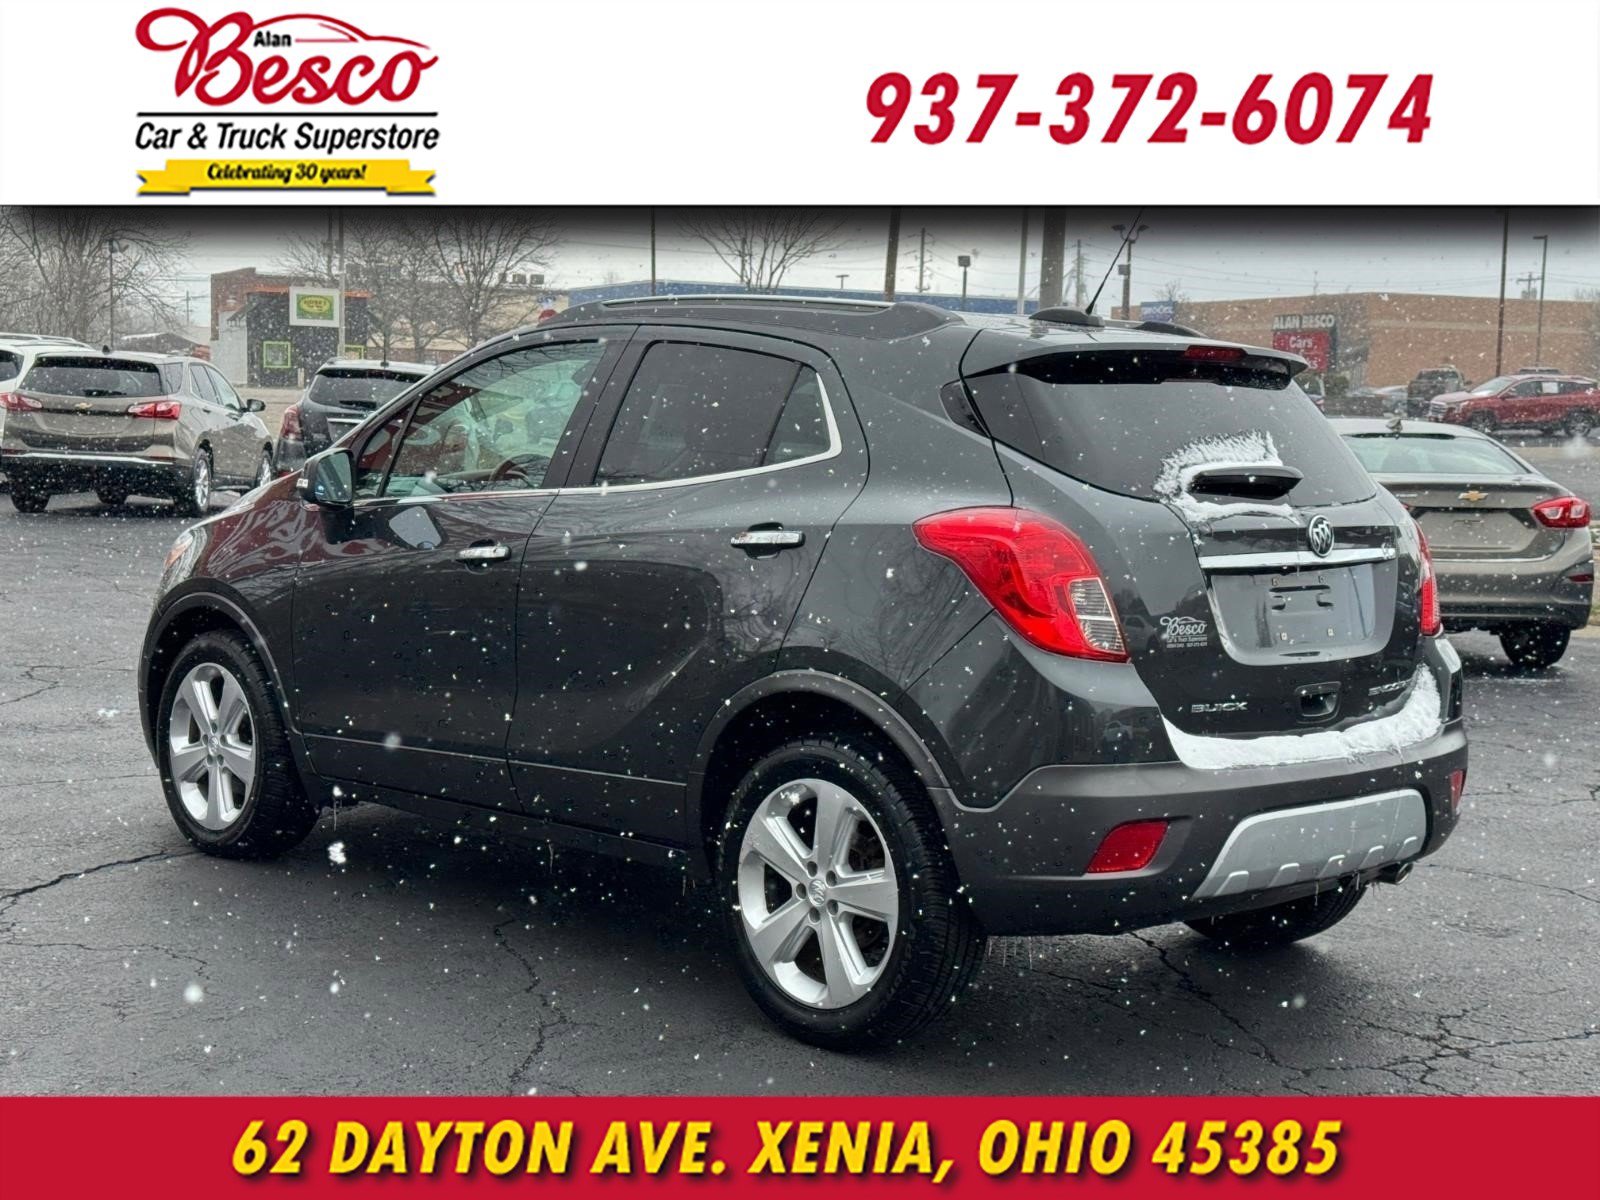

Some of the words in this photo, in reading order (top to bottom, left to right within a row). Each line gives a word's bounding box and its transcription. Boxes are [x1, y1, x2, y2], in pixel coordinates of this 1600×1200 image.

[1272, 315, 1300, 330] ALAN
[1160, 616, 1208, 636] Besco
[1191, 701, 1248, 713] BUICK
